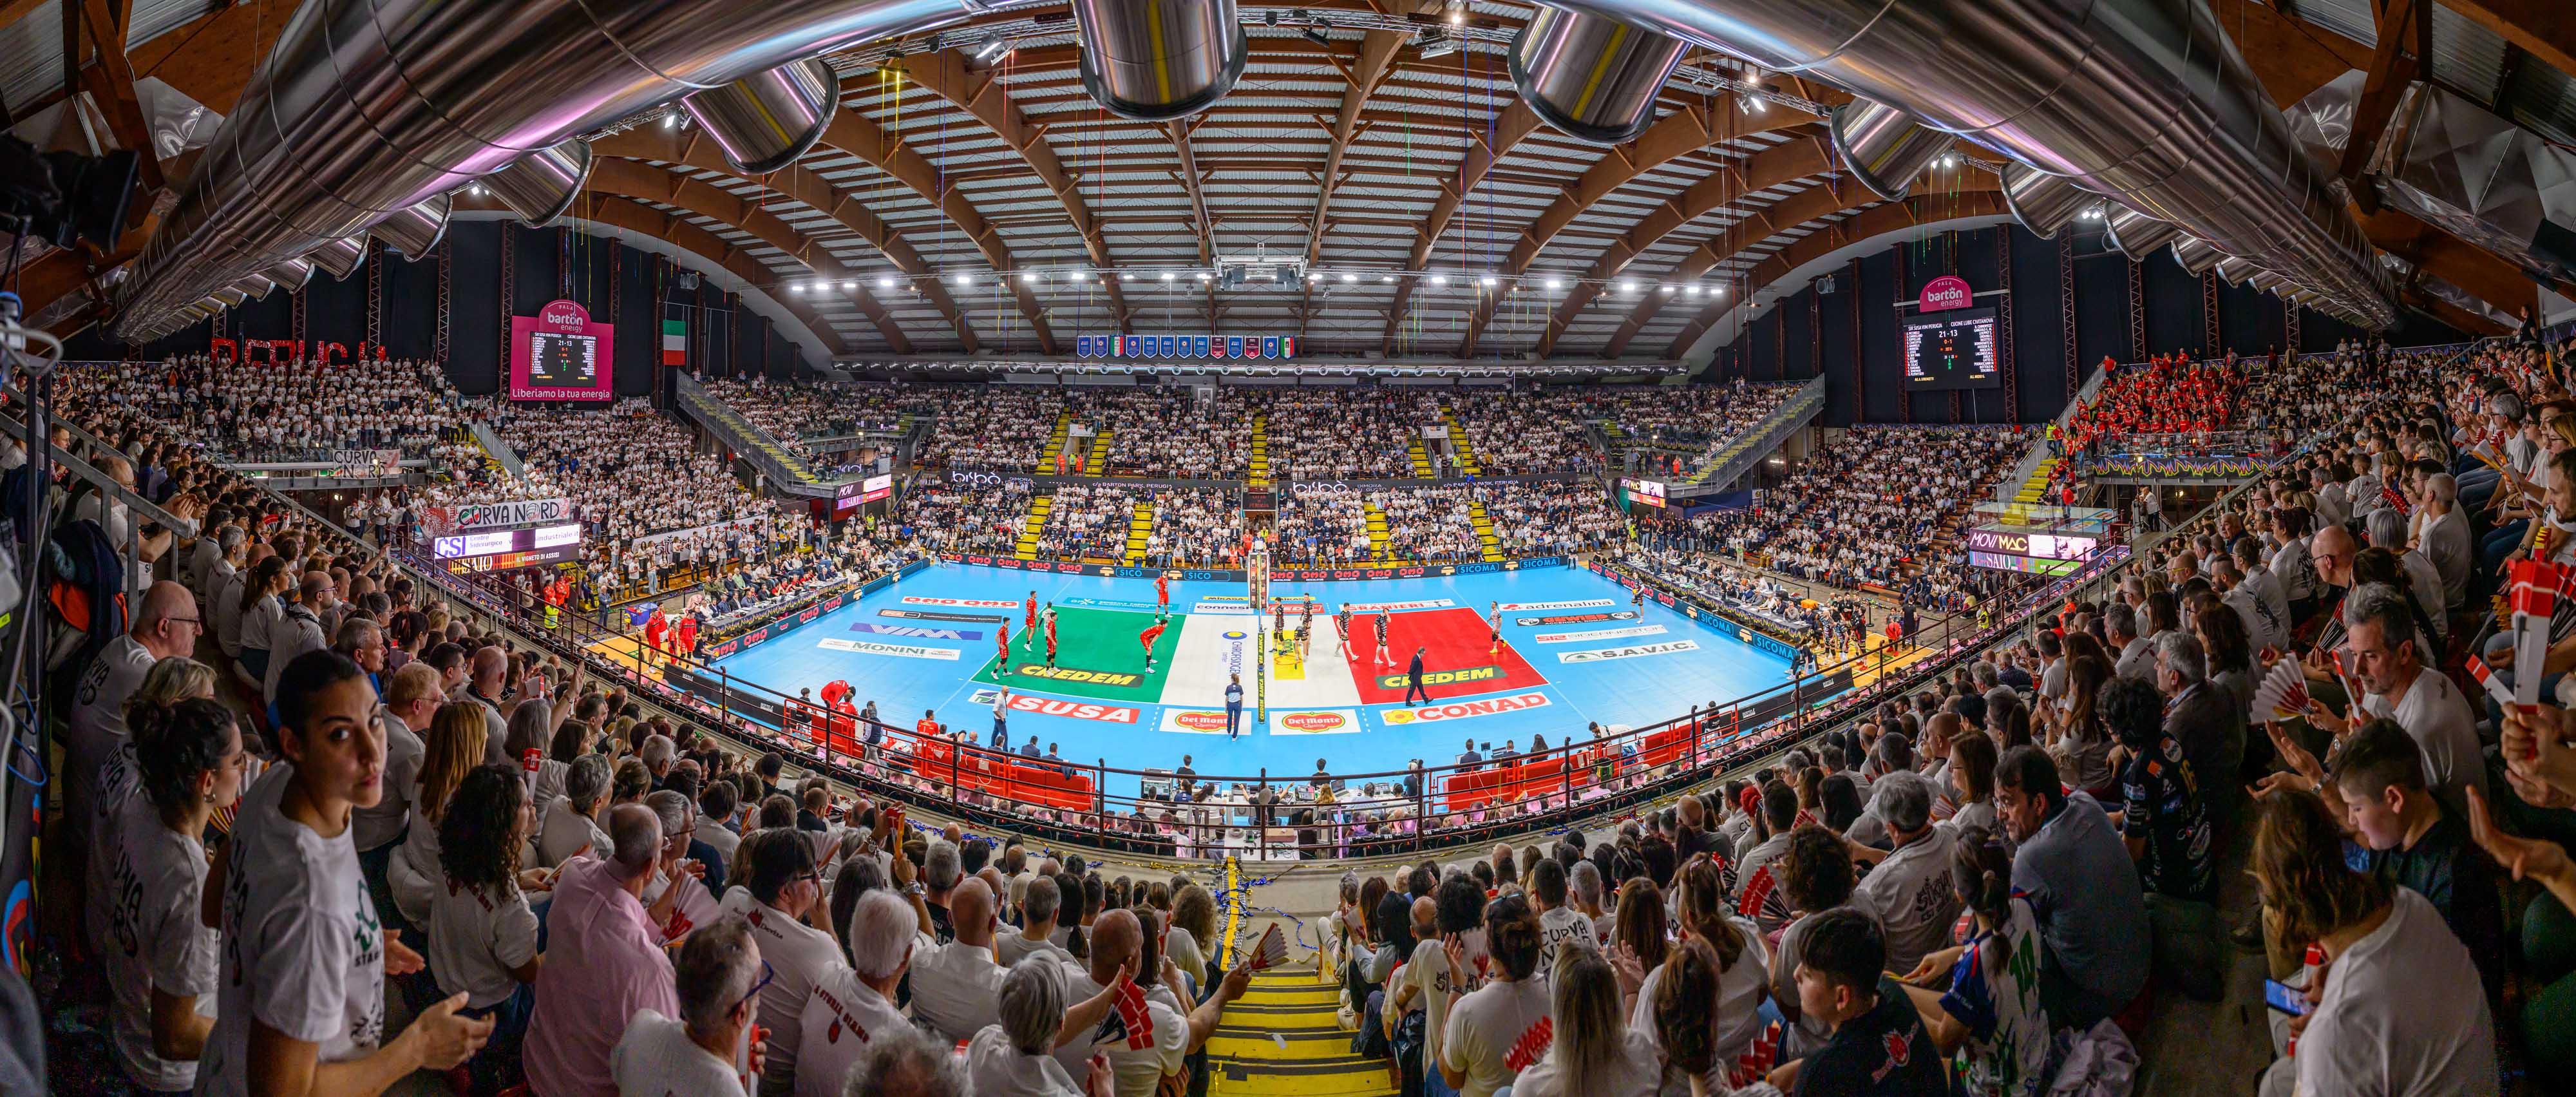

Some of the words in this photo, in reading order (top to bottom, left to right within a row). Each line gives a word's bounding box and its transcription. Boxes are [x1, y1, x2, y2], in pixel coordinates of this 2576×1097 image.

[1940, 298, 1963, 307] energy
[560, 324, 583, 333] energy
[513, 388, 556, 398] Liberiamo
[558, 389, 565, 397] la
[567, 390, 580, 398] tua
[582, 390, 610, 399] energia
[334, 450, 377, 464] CURVA
[458, 505, 509, 526] CURVA
[515, 501, 560, 522] NORD
[437, 535, 466, 558] CSI
[1523, 558, 1557, 568] SICOMA
[1987, 553, 2011, 570] SAIO
[1460, 564, 1495, 573] SICOMA
[1526, 601, 1611, 611] adrenalina
[1542, 613, 1609, 623] GEWISS
[1701, 613, 1731, 634] SICOMA
[870, 624, 962, 640] VIM
[852, 642, 927, 654] MONINI
[1602, 643, 1694, 658] S.A.V.I.C.
[1757, 636, 1794, 660] SICOMA
[1012, 697, 1132, 723] SUSA
[1417, 694, 1546, 721] CONAD
[1181, 716, 1199, 724] Del
[1200, 716, 1229, 724] Mont
[1305, 716, 1340, 724] Monte
